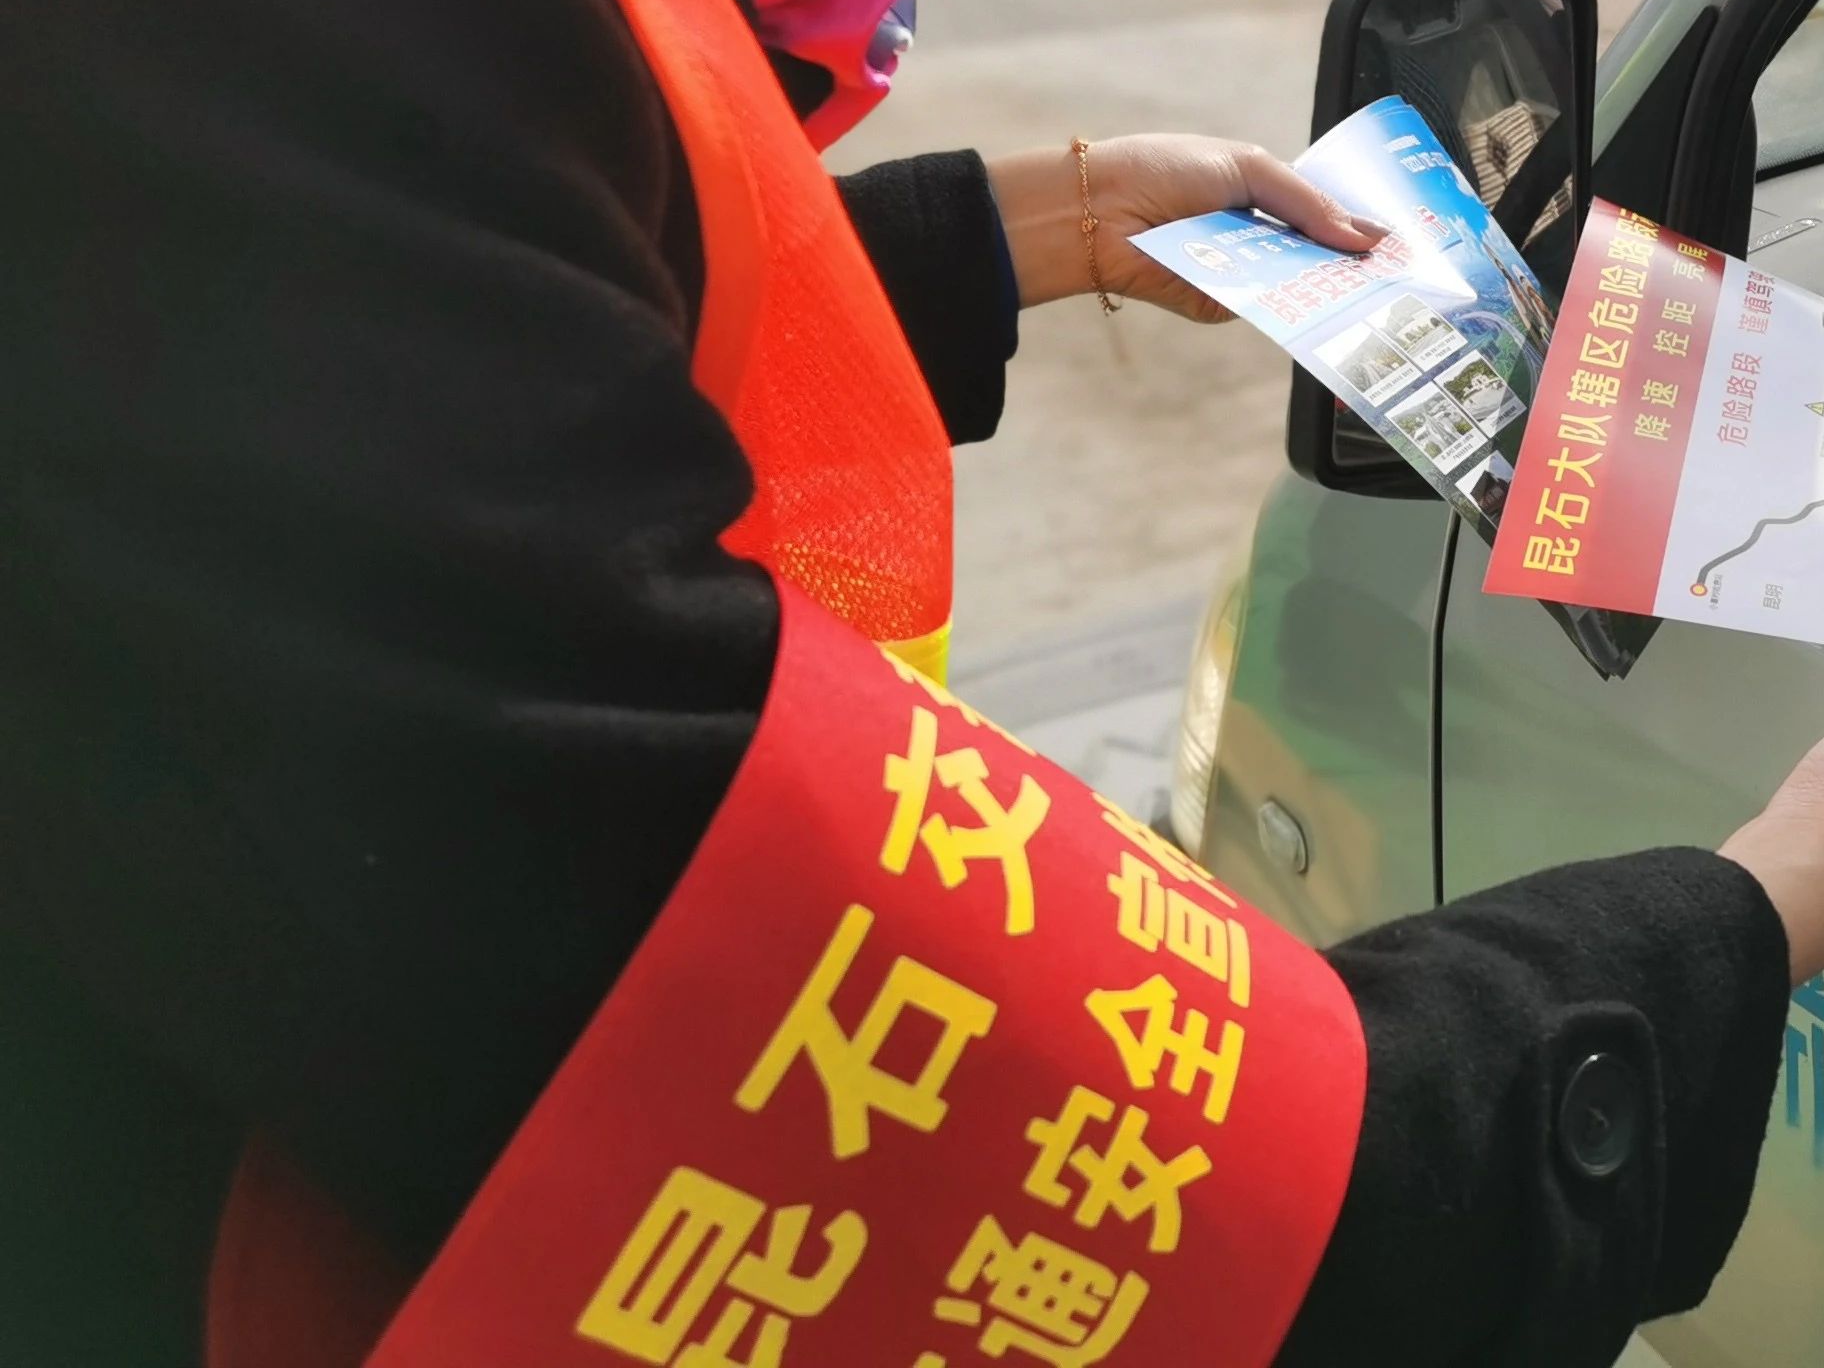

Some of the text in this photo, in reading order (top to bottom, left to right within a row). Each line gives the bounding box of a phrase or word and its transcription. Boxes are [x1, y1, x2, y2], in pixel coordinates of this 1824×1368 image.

[1716, 352, 1763, 447] 危险路段
[575, 644, 1049, 1368] 昆石交
[912, 789, 1250, 1368] 通安全宣
